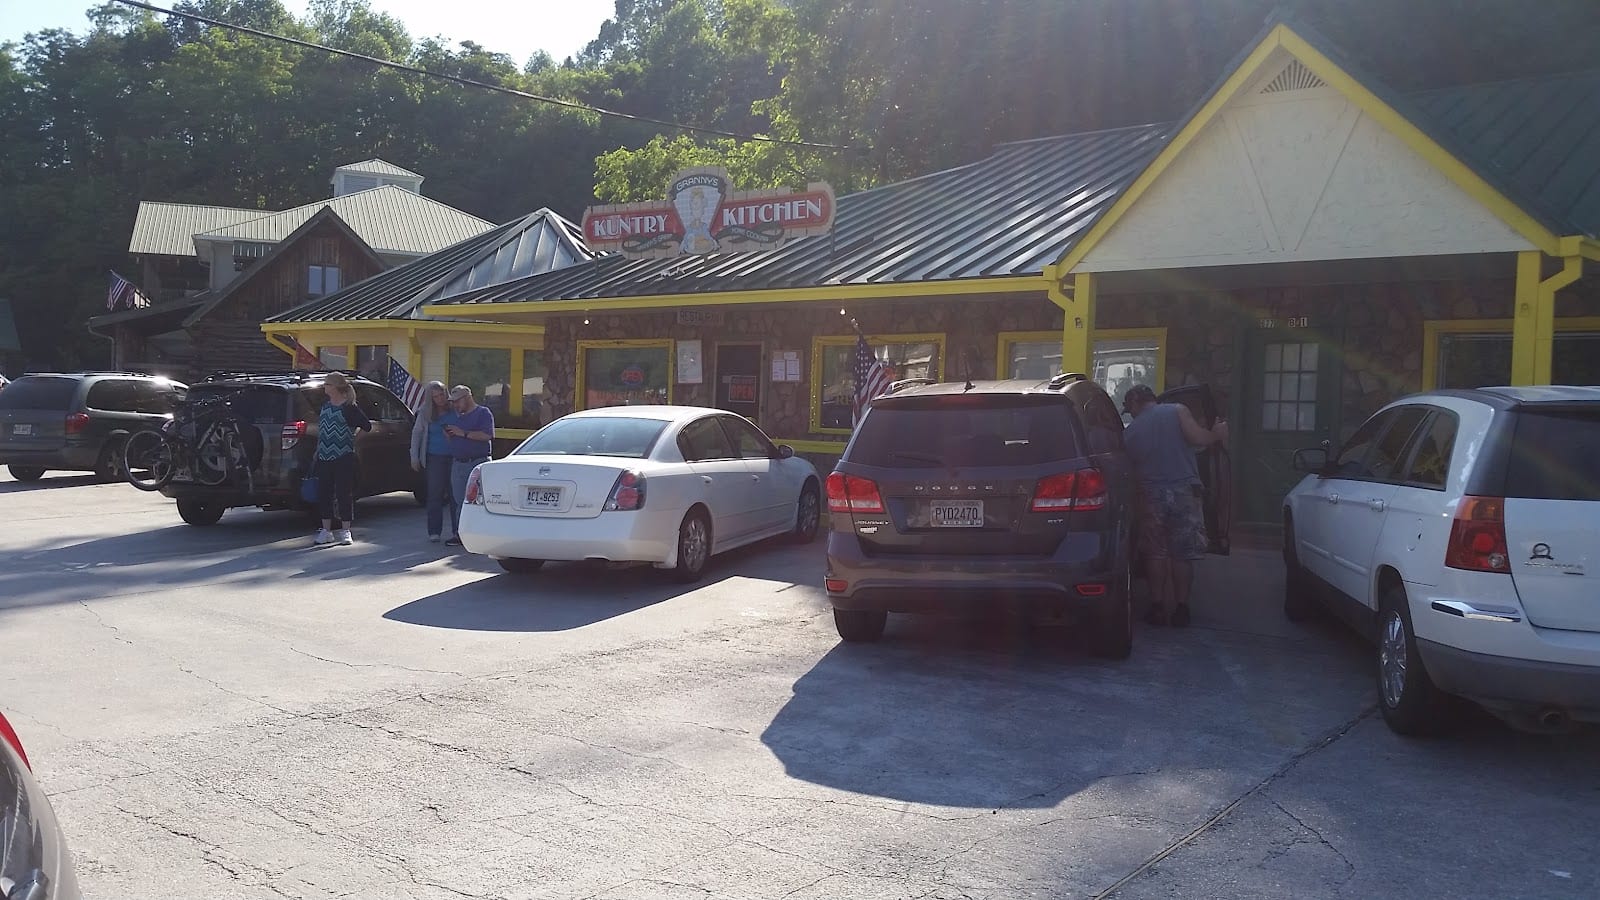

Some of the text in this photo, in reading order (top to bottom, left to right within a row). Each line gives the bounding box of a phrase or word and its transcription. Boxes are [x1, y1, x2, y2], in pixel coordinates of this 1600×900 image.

[593, 198, 822, 237] KUNTRY KITCHEN
[730, 384, 754, 400] OPEN
